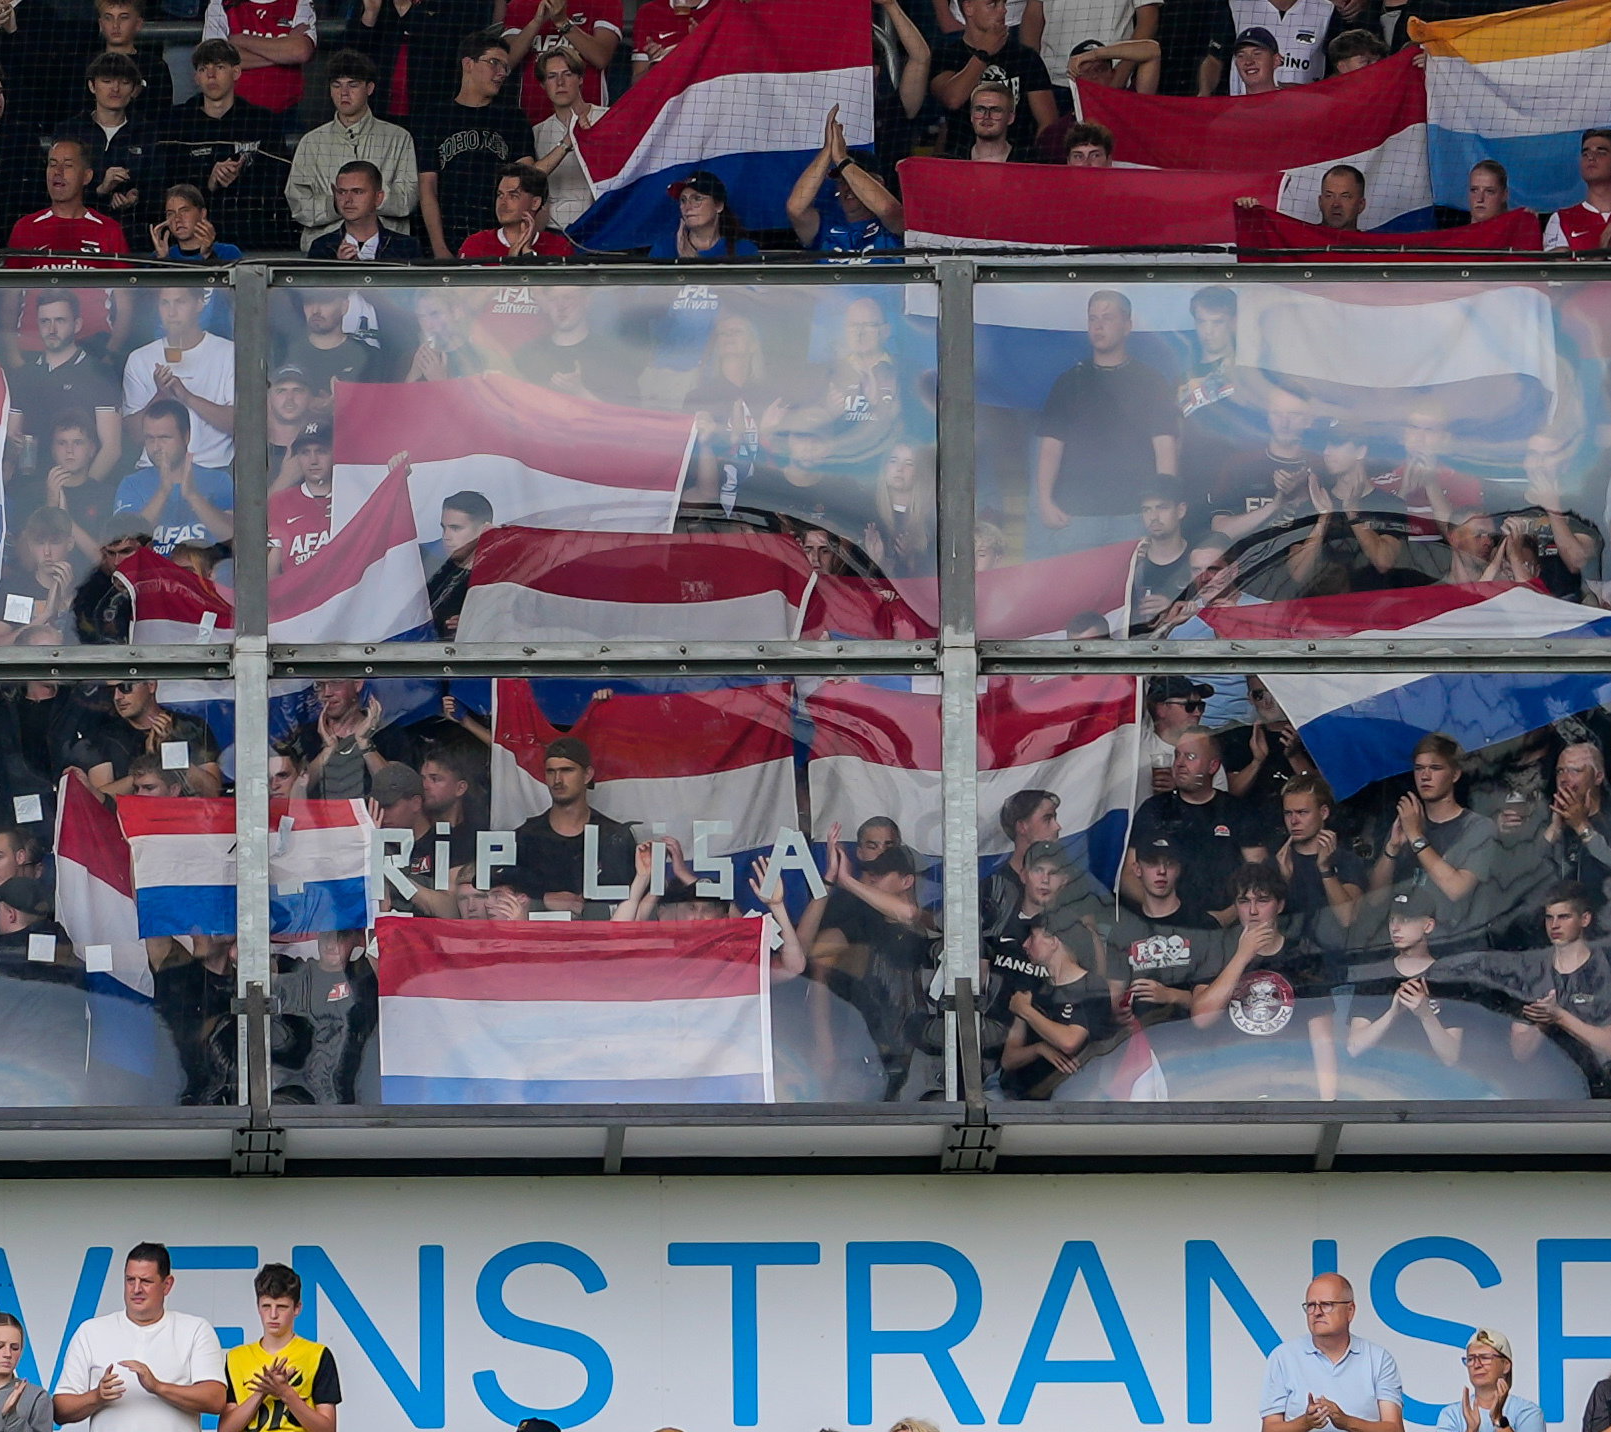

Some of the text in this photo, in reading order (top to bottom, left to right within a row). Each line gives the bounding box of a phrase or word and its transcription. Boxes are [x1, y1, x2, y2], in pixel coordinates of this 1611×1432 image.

[153, 523, 207, 544] AFAS
[289, 530, 331, 556] AFA
[993, 954, 1050, 979] KANSIN
